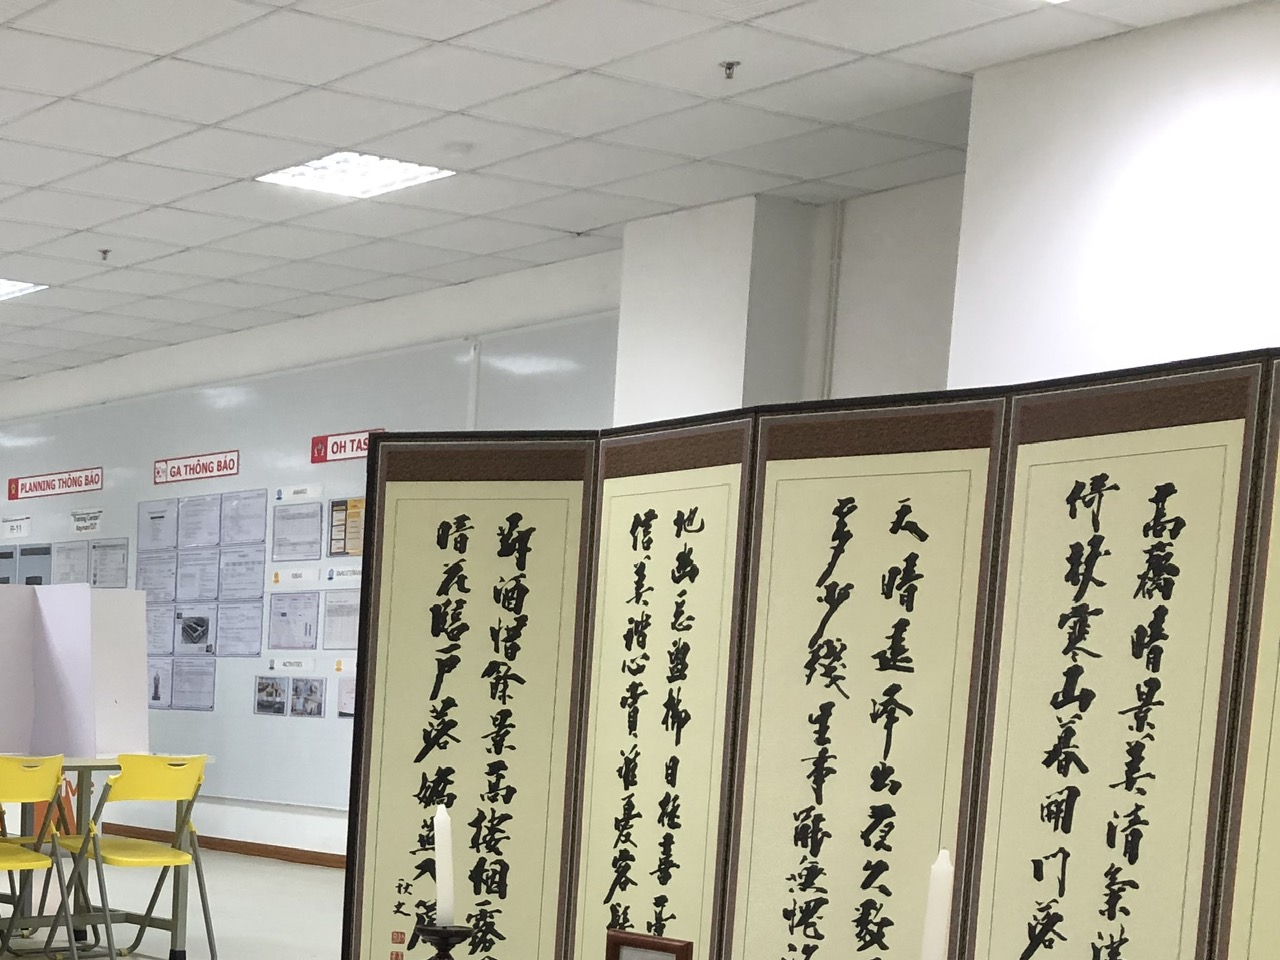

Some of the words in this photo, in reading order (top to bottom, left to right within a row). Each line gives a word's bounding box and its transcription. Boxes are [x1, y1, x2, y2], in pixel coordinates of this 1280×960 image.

[331, 440, 347, 455] OH
[350, 437, 369, 452] TAS
[169, 465, 182, 478] GA
[184, 459, 214, 476] THÔNG
[216, 455, 235, 472] BÁO
[20, 479, 56, 494] PLANNING
[57, 473, 83, 489] THÔNG
[84, 470, 100, 486] BÁO
